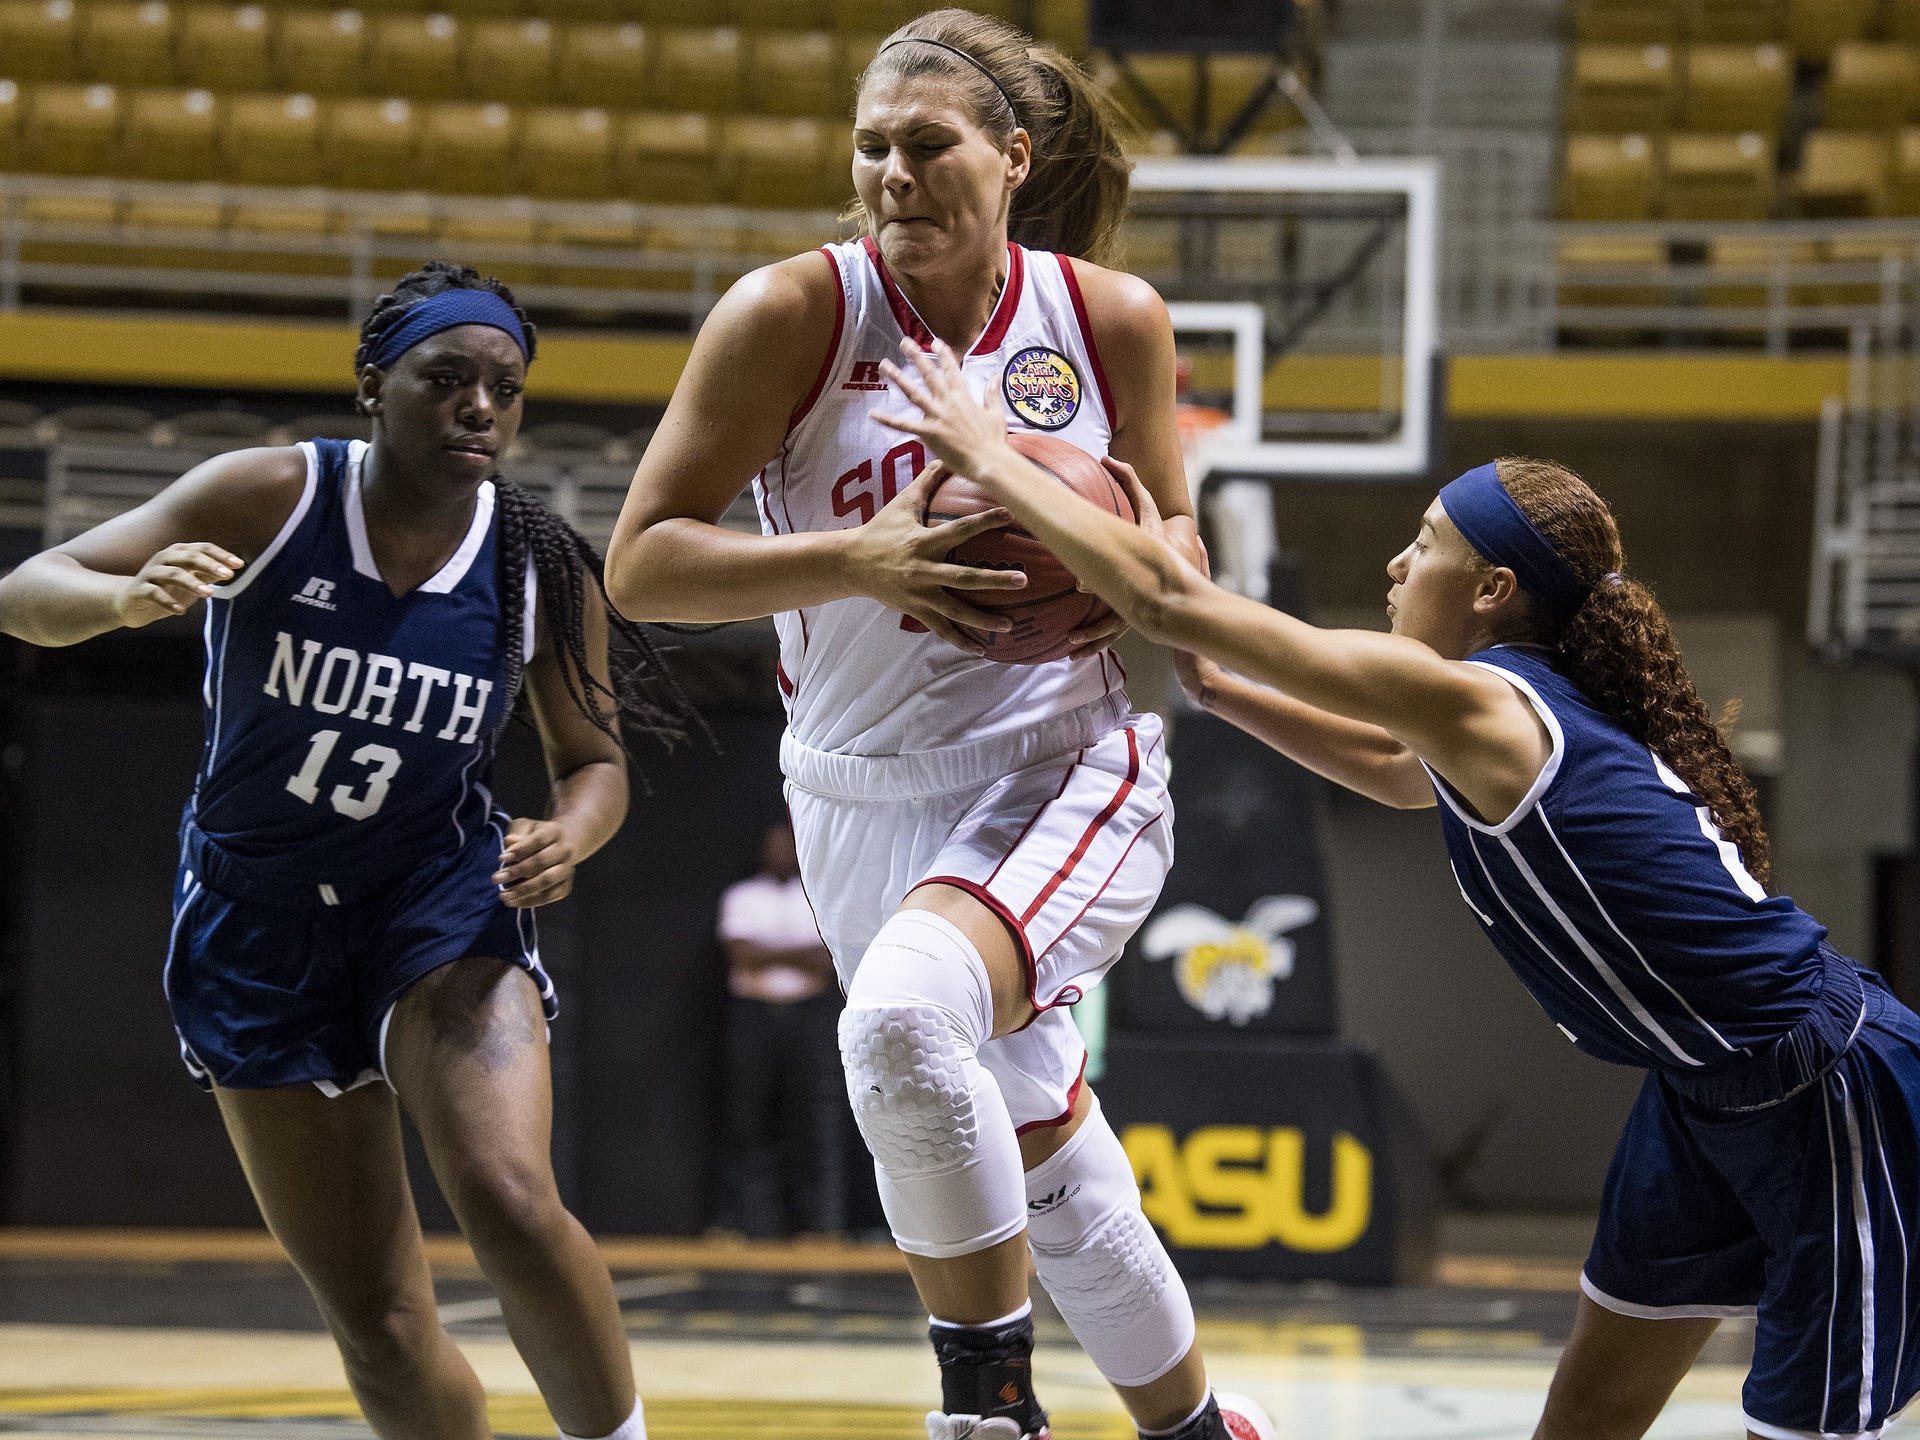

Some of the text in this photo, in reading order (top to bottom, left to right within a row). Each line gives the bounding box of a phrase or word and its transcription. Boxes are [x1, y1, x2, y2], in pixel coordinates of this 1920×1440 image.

[1009, 373, 1075, 401] STARS
[1026, 363, 1055, 377] ALL
[301, 576, 337, 601] R
[263, 631, 493, 744] NORTH
[285, 729, 402, 821] 13
[1120, 1123, 1374, 1253] ASU
